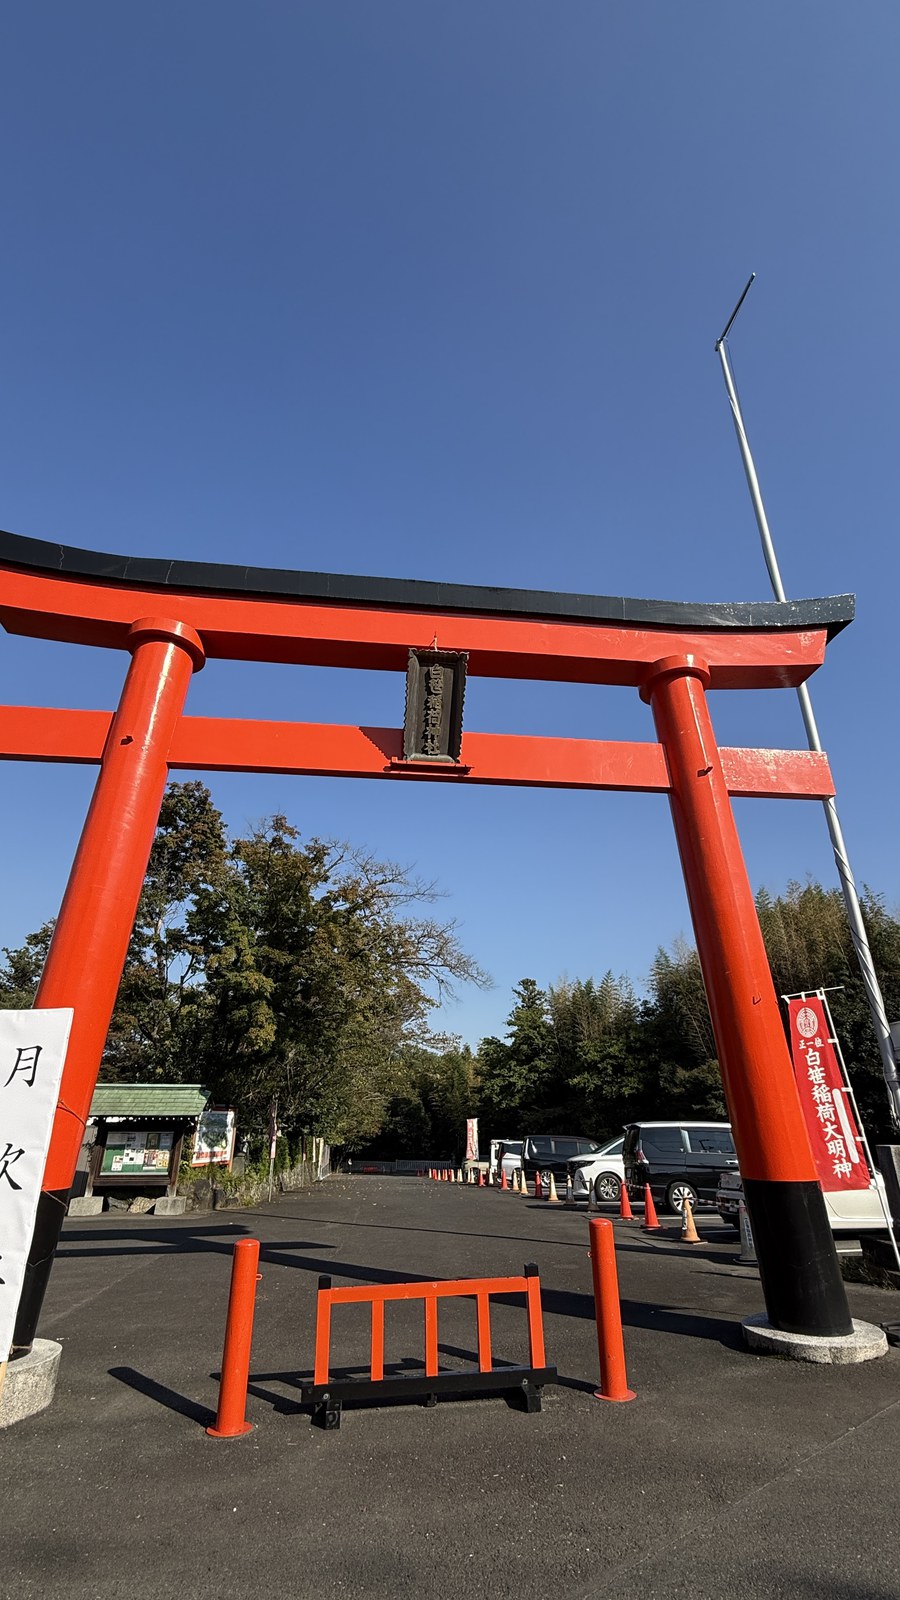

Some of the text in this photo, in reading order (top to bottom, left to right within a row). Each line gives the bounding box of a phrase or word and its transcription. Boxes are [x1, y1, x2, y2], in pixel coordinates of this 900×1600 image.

[799, 1036, 825, 1050] 正一位
[805, 1048, 852, 1179] 白笹稲荷大明神
